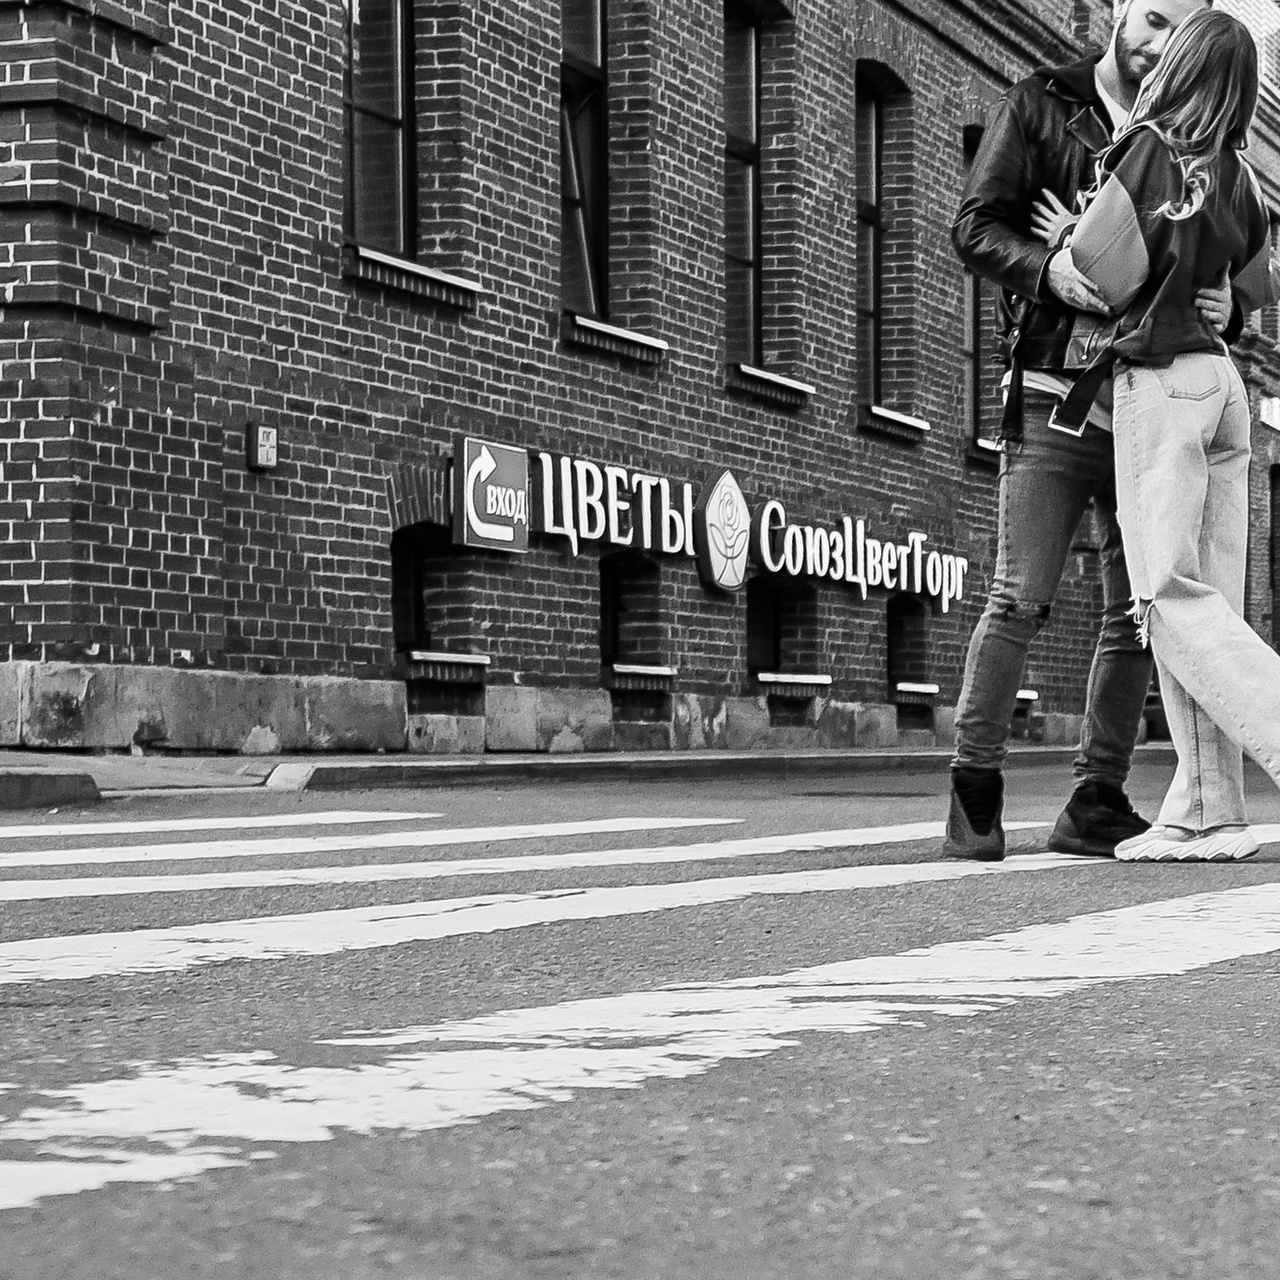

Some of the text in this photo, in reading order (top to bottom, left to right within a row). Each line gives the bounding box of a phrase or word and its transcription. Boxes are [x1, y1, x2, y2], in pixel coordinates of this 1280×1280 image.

[486, 484, 526, 525] ВХОД
[539, 452, 968, 614] ЦВЕТЫ СоюзЦветТорг
